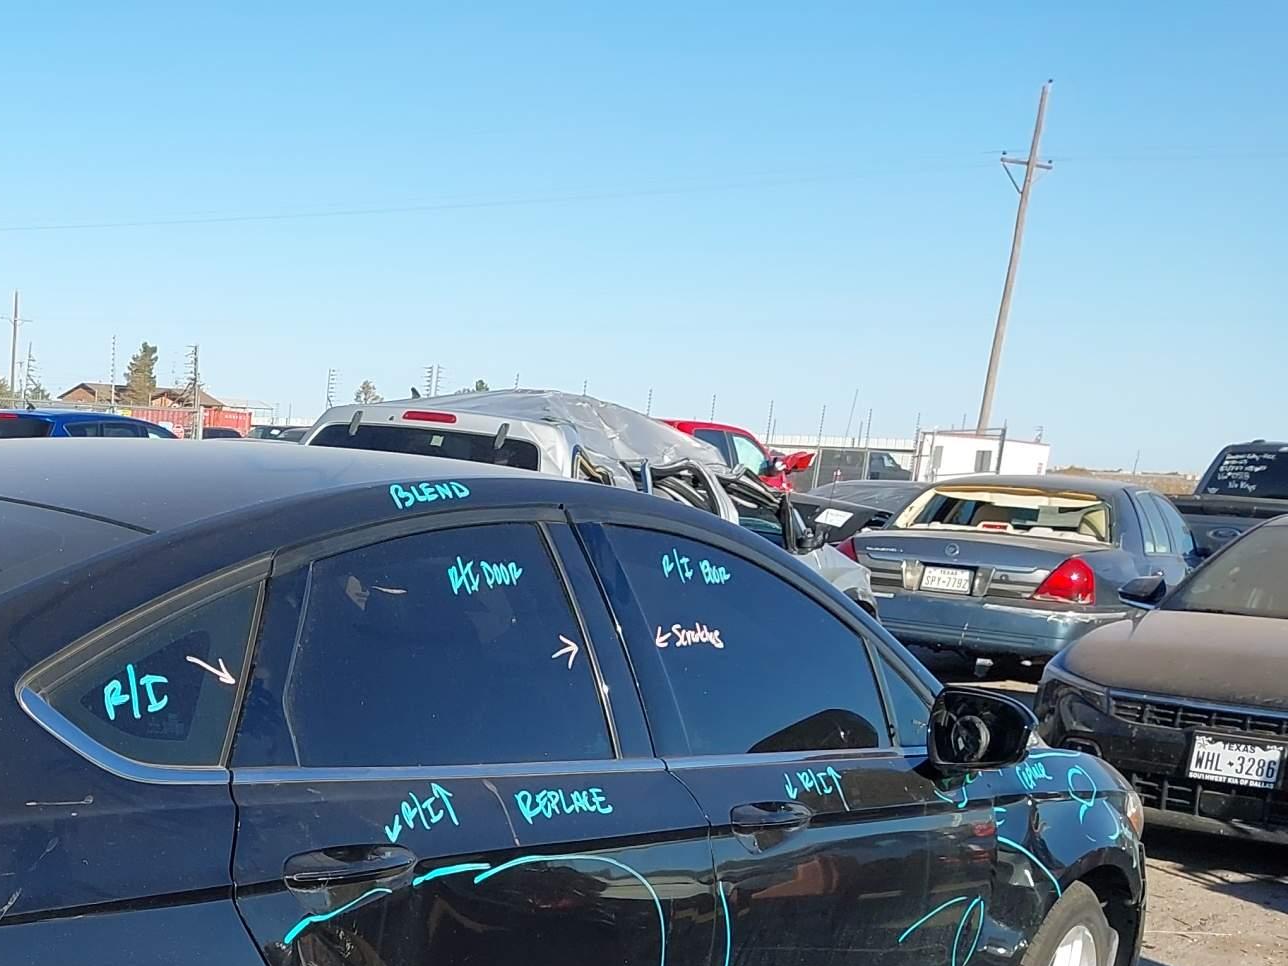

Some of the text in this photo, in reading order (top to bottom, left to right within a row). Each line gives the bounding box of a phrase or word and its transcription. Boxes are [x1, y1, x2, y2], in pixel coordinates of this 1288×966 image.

[389, 482, 470, 510] BLEND
[103, 663, 169, 721] R/I
[1223, 742, 1256, 754] TEXAS
[1194, 750, 1277, 779] WHL 3286
[1227, 777, 1239, 785] KIA
[514, 787, 613, 824] REPLACE
